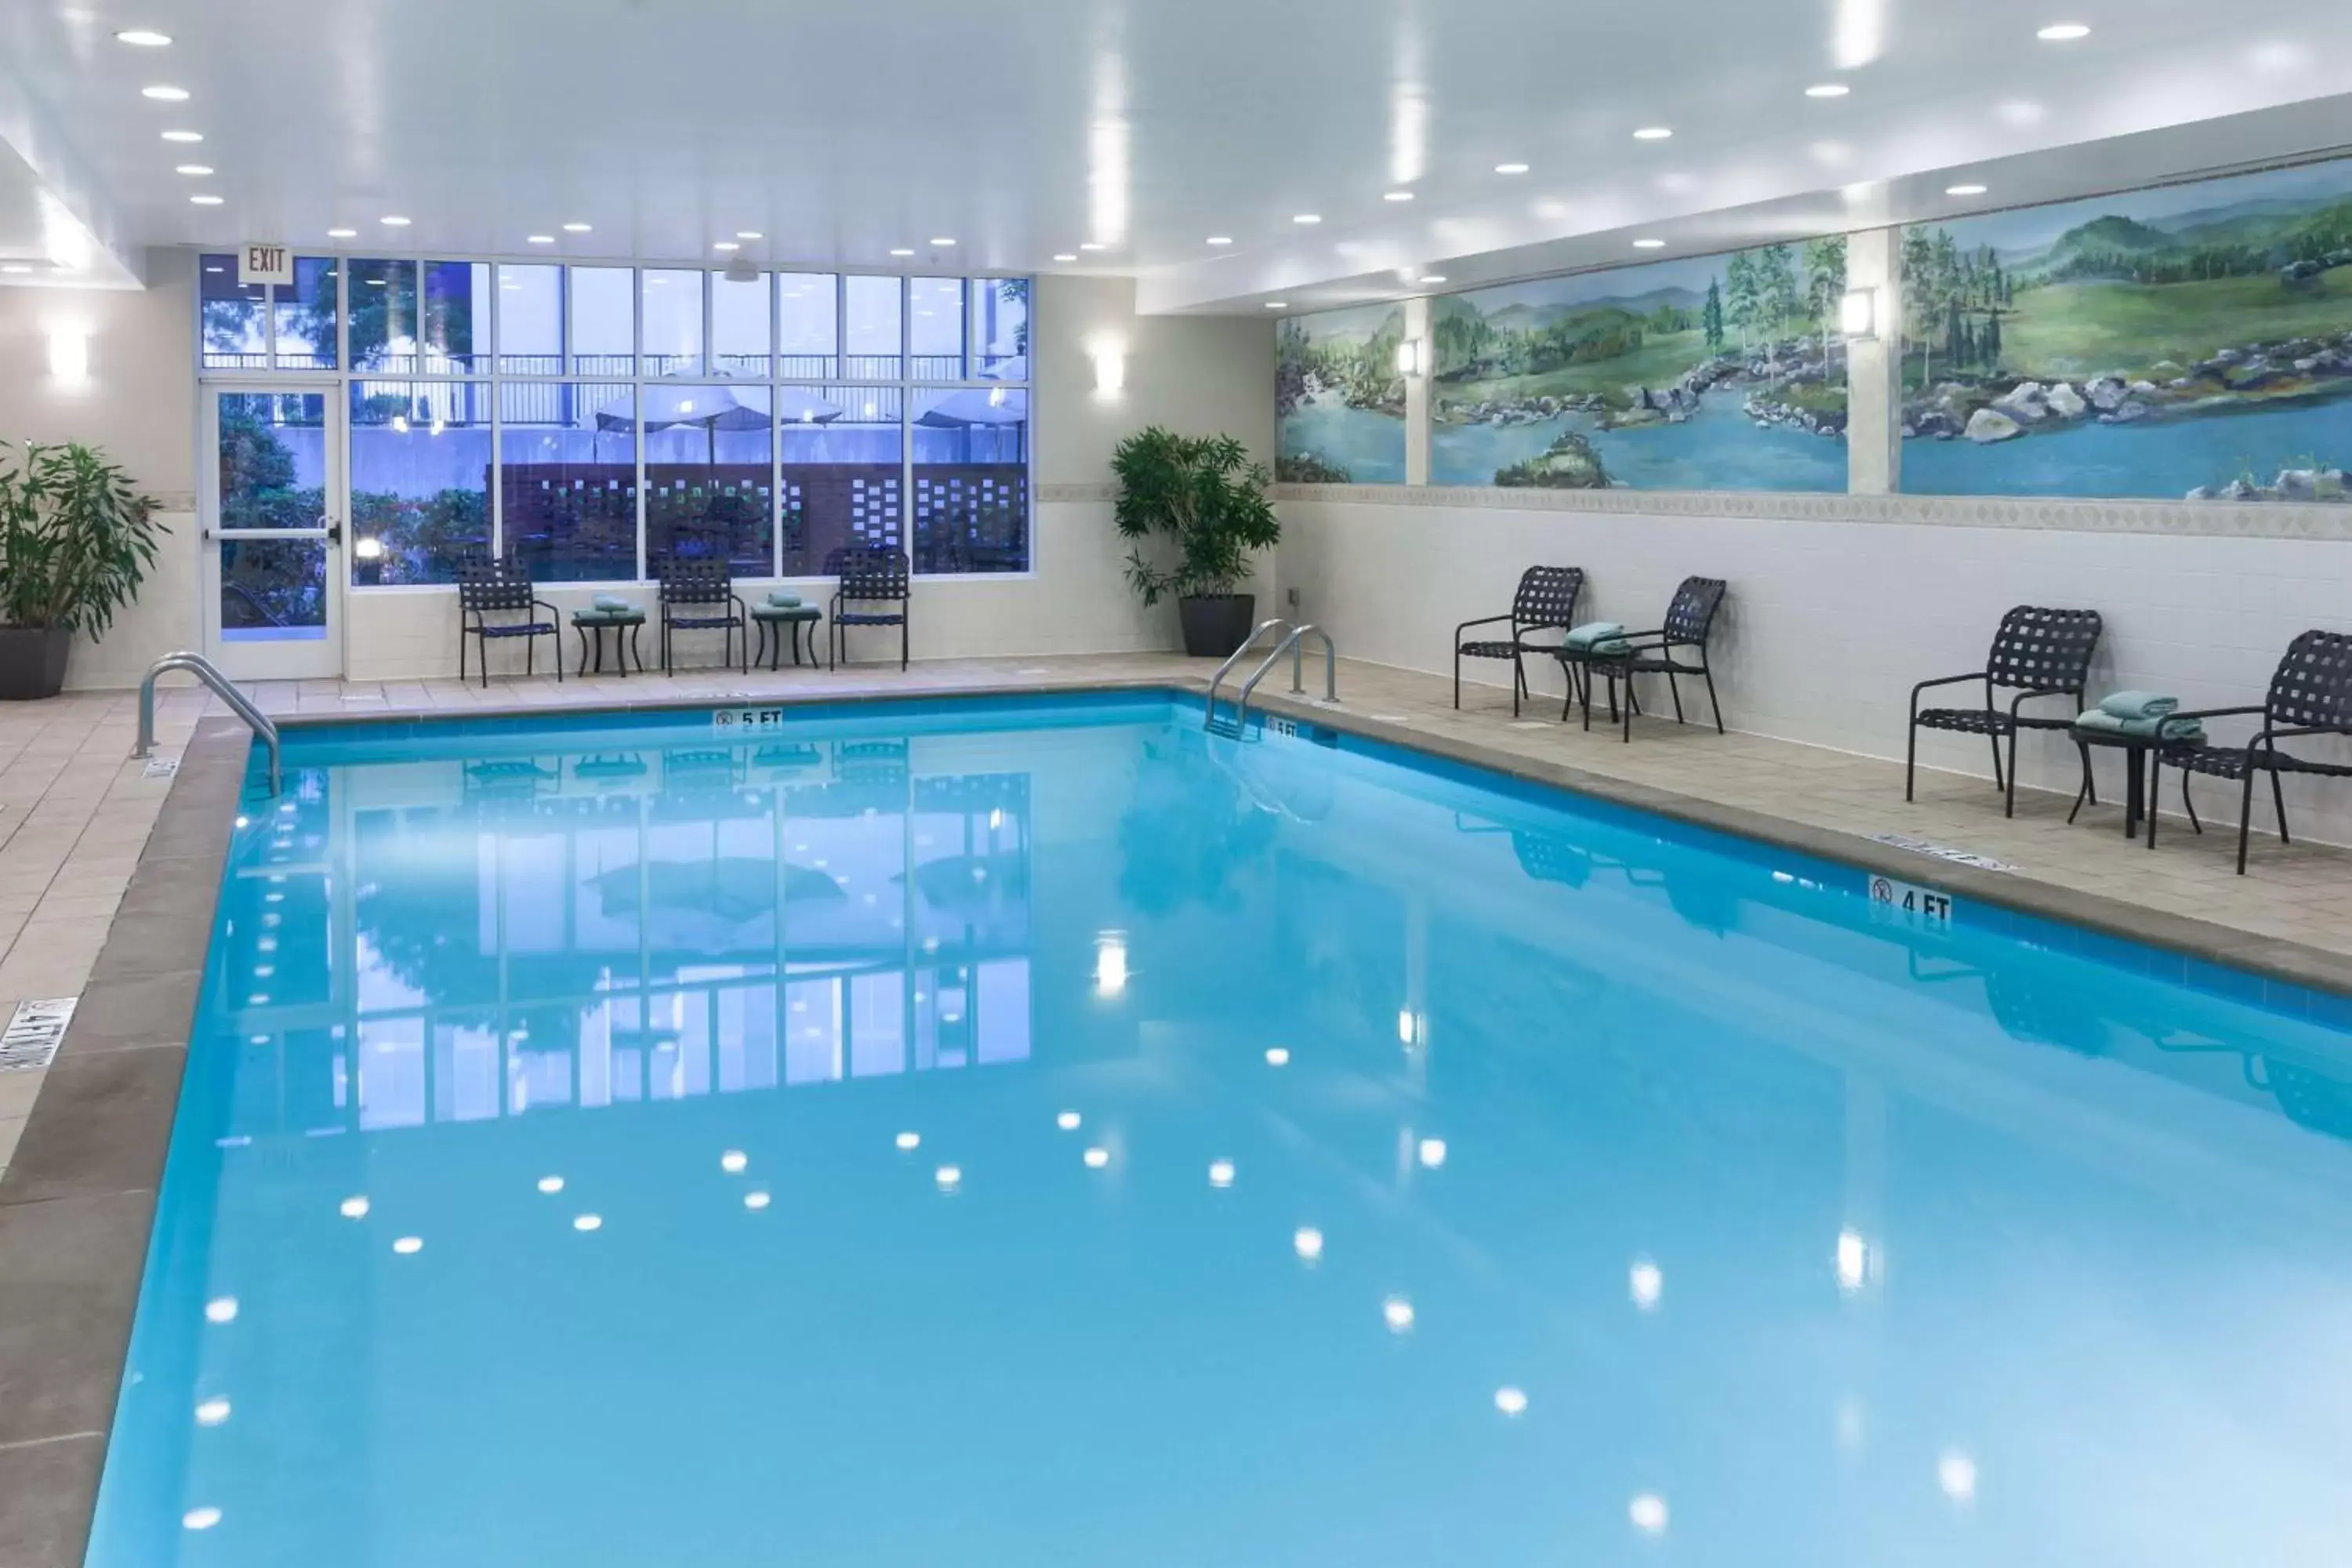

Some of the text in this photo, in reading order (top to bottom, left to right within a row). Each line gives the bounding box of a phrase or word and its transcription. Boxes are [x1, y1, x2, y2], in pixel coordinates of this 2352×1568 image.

[249, 247, 285, 272] EXIT
[742, 711, 782, 724] 5 FT
[1902, 890, 1950, 920] 4 FT
